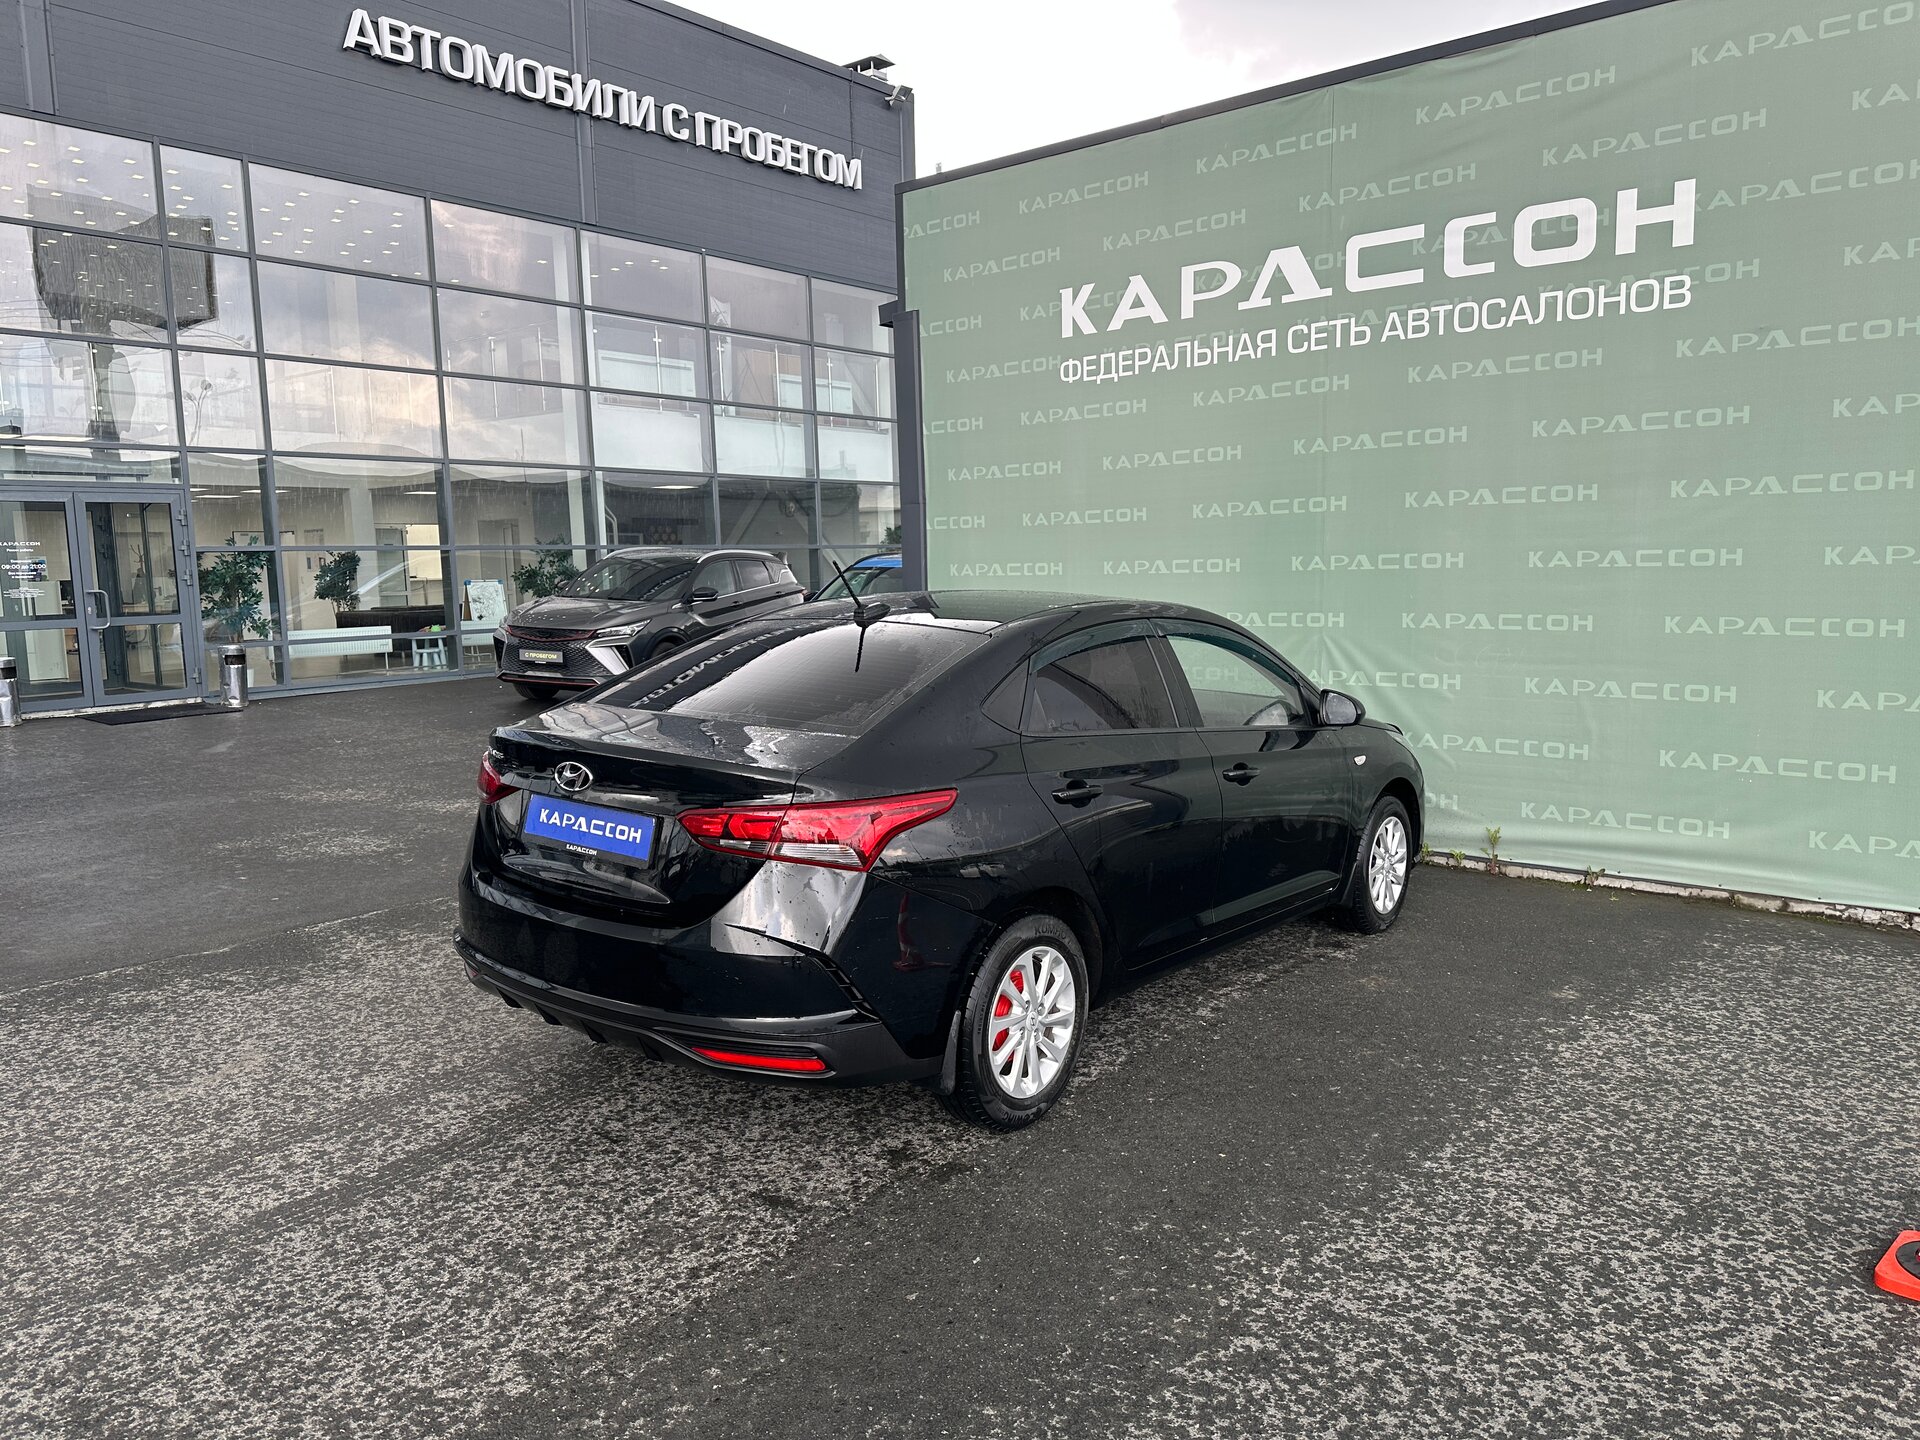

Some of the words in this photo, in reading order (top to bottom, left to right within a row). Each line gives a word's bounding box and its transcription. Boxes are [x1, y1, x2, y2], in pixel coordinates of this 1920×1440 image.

[343, 8, 656, 132] АВТОМОБИЛИ
[663, 103, 690, 141] С
[695, 111, 863, 190] ПРОБЕГОМ
[1416, 66, 1615, 125] КАРАССОН
[1197, 123, 1356, 174] КАРАССОН
[1543, 108, 1766, 166] КАРАССОН
[1019, 171, 1148, 213] КАРАССОН
[1299, 163, 1475, 212] КАРАССОН
[1103, 209, 1246, 251] КАРАССОН
[944, 247, 1060, 282] КАРАССОН
[1060, 178, 1696, 338] КАРАССОН
[1060, 328, 1277, 384] ФЕДЕРАЛЬНАЯ
[1286, 314, 1371, 356] СЕТЬ
[1380, 275, 1692, 342] АВТОСАЛОНОВ
[946, 354, 1058, 383] КАРАССОН
[1408, 348, 1602, 383] КАРАССОН
[1194, 374, 1349, 406] КАРАССОН
[1021, 399, 1146, 425] КАРАССОН
[1533, 406, 1750, 437] КАРАССОН
[1294, 426, 1467, 454] КАРАССОН
[948, 461, 1061, 480] КАРАССОН
[1103, 445, 1241, 470] КАРАССОН
[1405, 484, 1597, 508] КАРАССОН
[1671, 470, 1914, 498] КАРАССОН
[1023, 507, 1146, 526] КАРАССОН
[1193, 495, 1347, 518] КАРАССОН
[950, 562, 1063, 577] КАРАССОН
[1104, 558, 1240, 575] КАРАССОН
[1292, 552, 1464, 571] КАРАССОН
[1529, 548, 1742, 568] КАРАССОН
[1402, 613, 1593, 631] КАРАССОН
[1665, 616, 1905, 638] КАРАССОН
[1525, 677, 1736, 703] КАРАССОН
[1660, 750, 1896, 784] КАРАССОН
[540, 808, 641, 844] КАРАССОН
[1520, 802, 1732, 841] КАРАССОН
